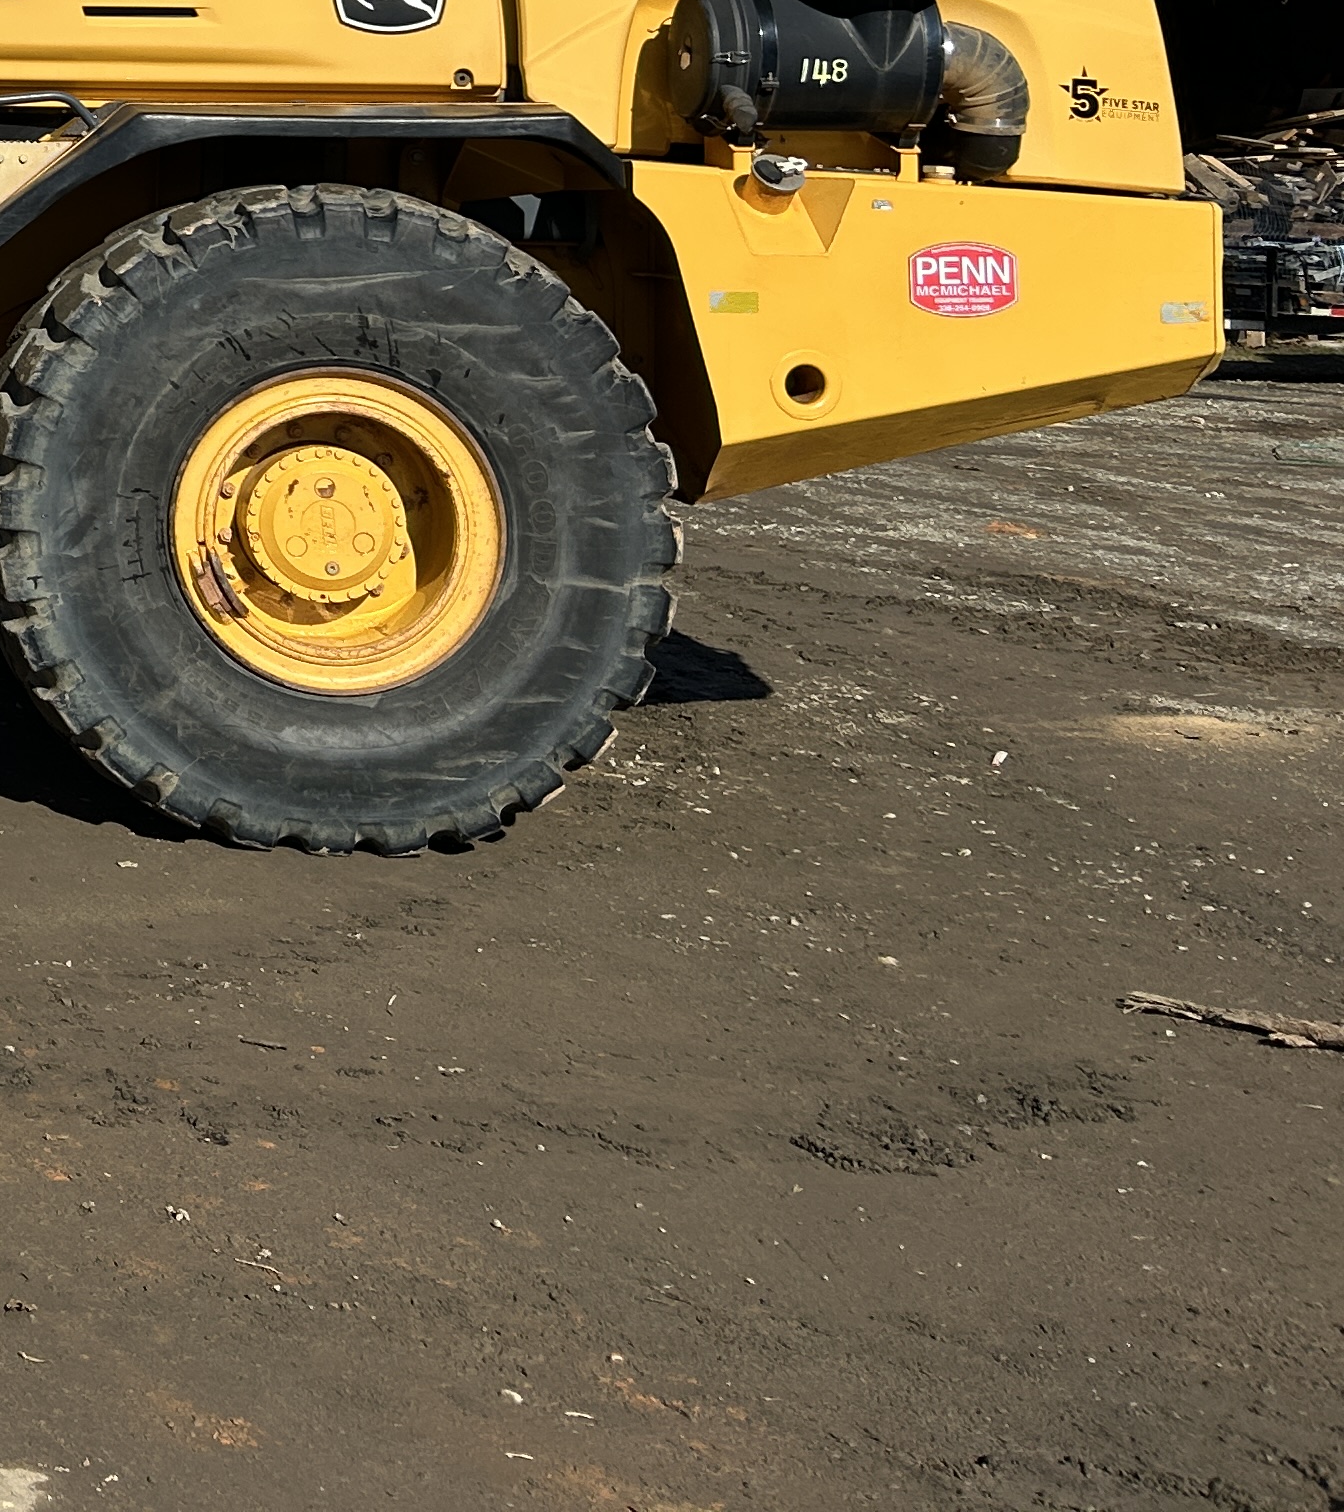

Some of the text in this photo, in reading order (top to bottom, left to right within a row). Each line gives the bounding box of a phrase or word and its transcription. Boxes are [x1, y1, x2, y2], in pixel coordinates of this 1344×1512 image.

[800, 58, 848, 87] 148
[1102, 97, 1160, 113] FIVE STAR
[1101, 109, 1160, 122] EQUIPMENT
[916, 256, 1010, 285] PENN
[916, 285, 1012, 296] MCMICHAEL
